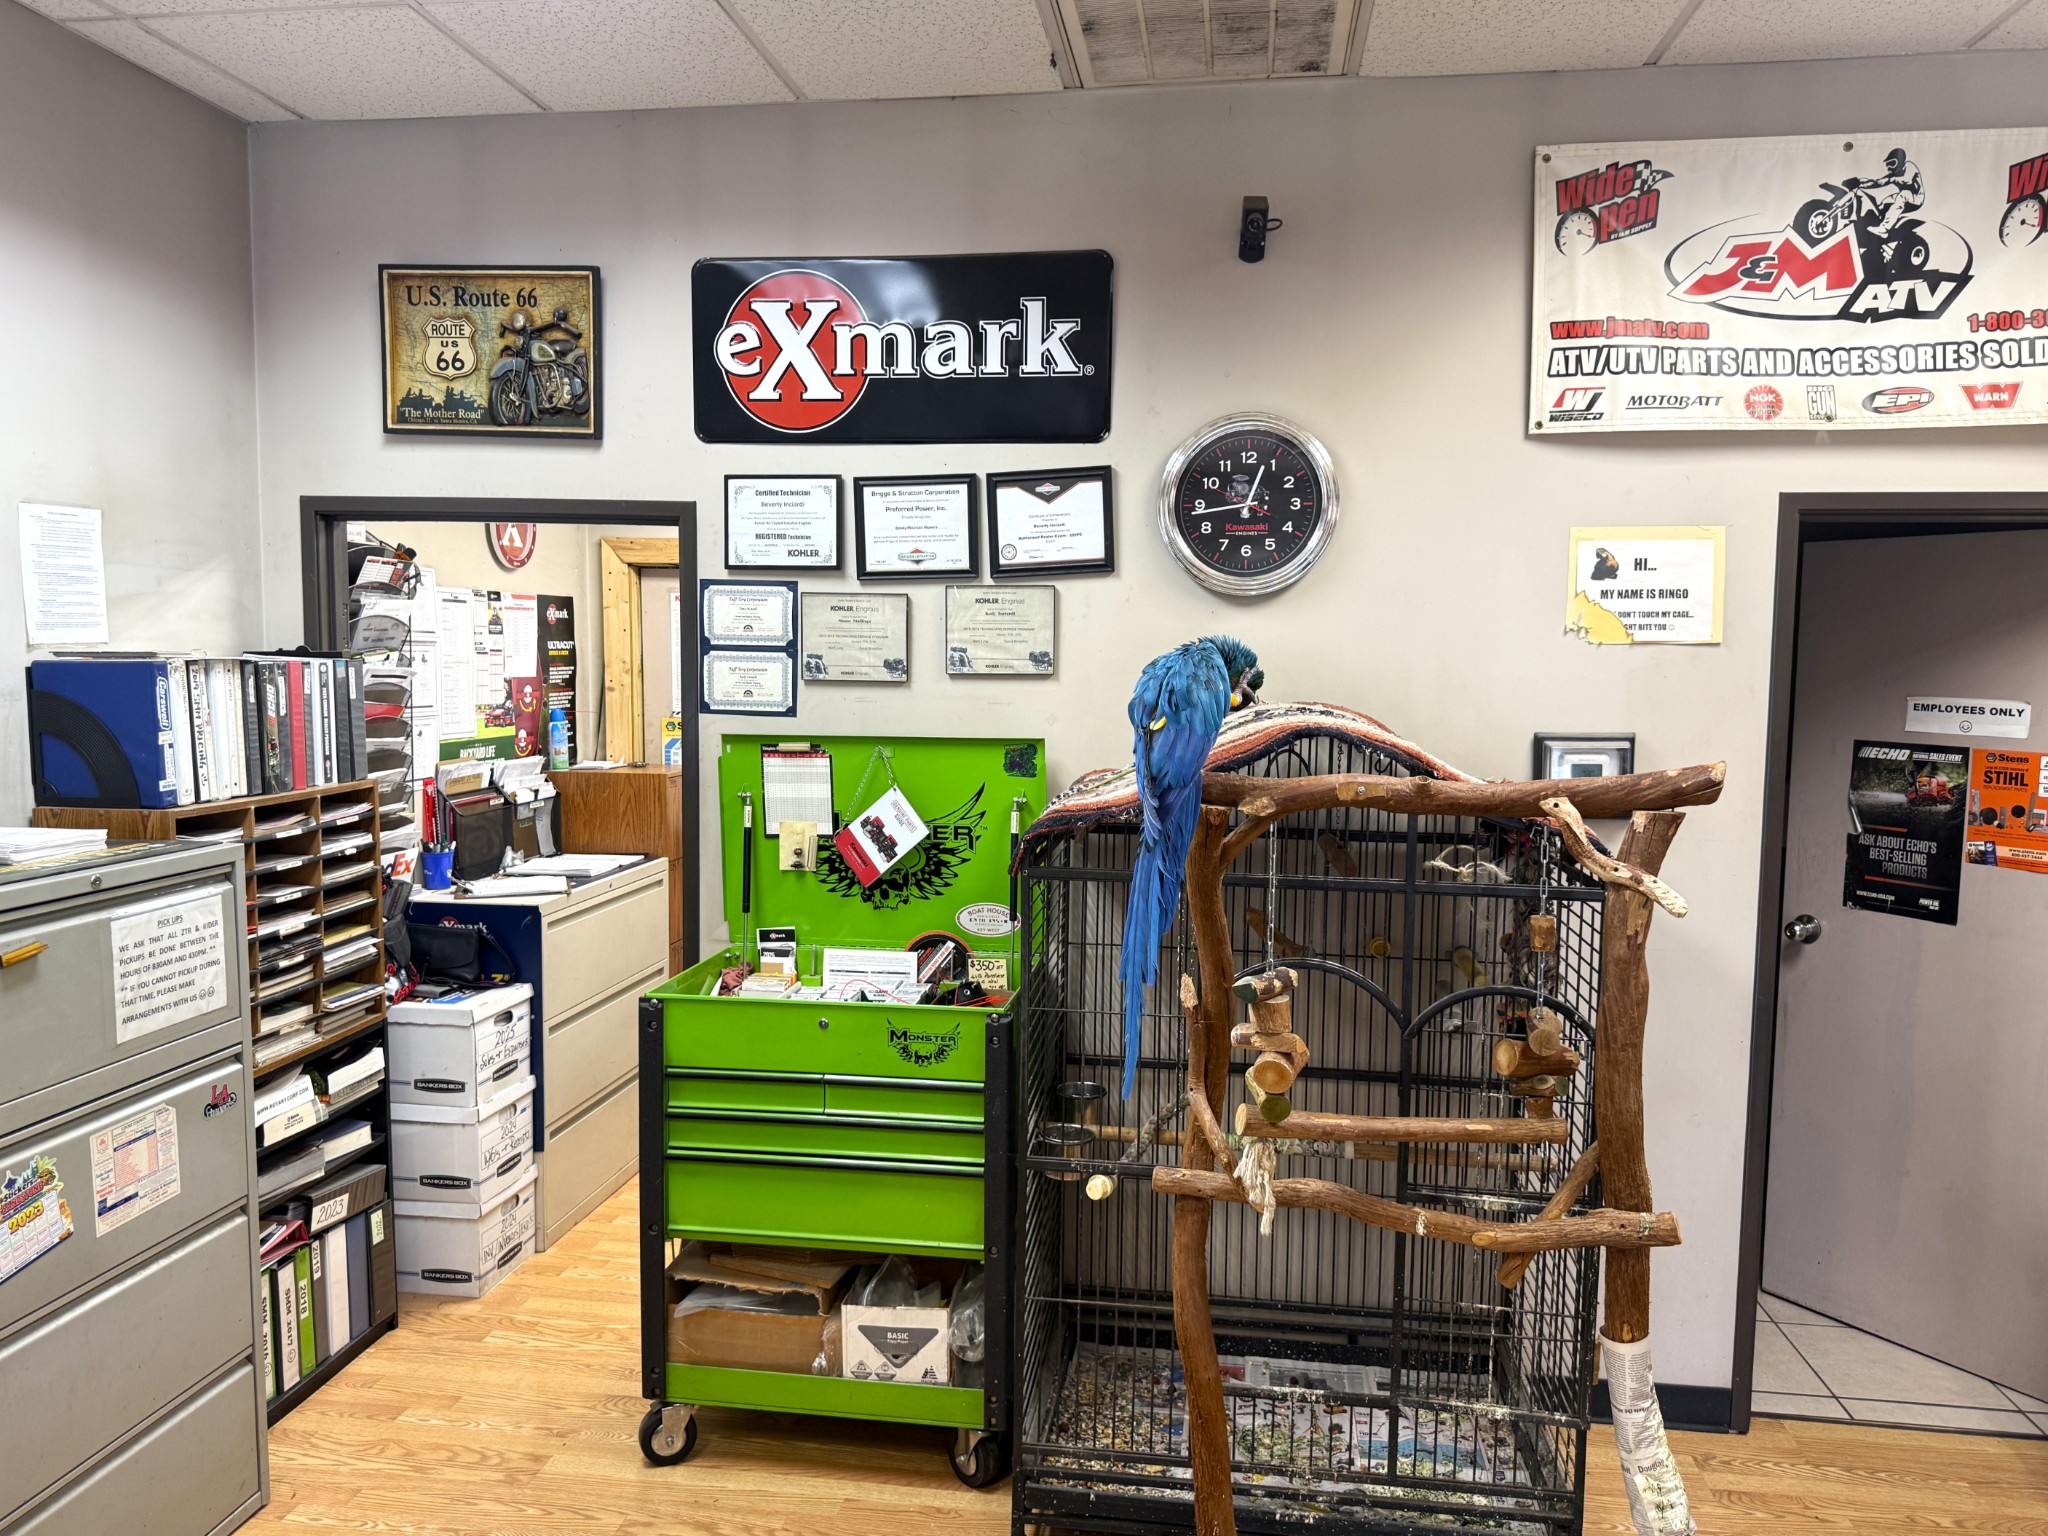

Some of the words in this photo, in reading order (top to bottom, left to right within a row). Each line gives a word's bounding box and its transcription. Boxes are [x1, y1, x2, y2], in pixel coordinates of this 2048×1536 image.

[1556, 163, 1635, 213] Wide
[1630, 222, 1653, 233] SUPPLY
[1683, 234, 1857, 296] J&M
[405, 285, 447, 307] U.S.
[453, 286, 510, 307] Route
[517, 287, 538, 308] 66
[1848, 280, 1957, 314] ATV
[431, 323, 465, 336] ROUTE
[1550, 317, 1710, 340] www.jmatv.com
[440, 340, 459, 348] US
[714, 296, 1084, 403] eXmark
[436, 351, 465, 372] 66
[1548, 344, 1659, 377] ATV/UTV
[1662, 346, 1740, 376] PARTS
[1741, 346, 1795, 377] AND
[1797, 340, 1979, 377] ACCESSORIES
[1980, 336, 2048, 369] SOLD
[1626, 395, 1724, 410] MOTOBATT
[1749, 393, 1776, 402] NGK
[1807, 391, 1836, 415] GUN
[1871, 393, 1930, 409] EPI
[1973, 392, 2009, 401] WARN
[400, 407, 422, 417] "The
[423, 408, 456, 418] Mother
[458, 408, 485, 419] Road"
[1549, 412, 1605, 423] WISECO
[1240, 452, 1258, 464] 12
[1270, 459, 1276, 471] 1
[1218, 460, 1231, 472] 11
[1202, 477, 1219, 490] 10
[1283, 476, 1295, 488] 2
[755, 489, 779, 497] Certified
[871, 490, 890, 498] Briggs
[924, 489, 960, 497] Corporation
[1194, 499, 1206, 511] 9
[1290, 498, 1301, 510] 3
[1201, 522, 1212, 534] 8
[1225, 522, 1269, 531] Kawasaki
[1282, 521, 1293, 533] 4
[1219, 539, 1230, 551] 7
[1240, 545, 1252, 557] 6
[1265, 538, 1276, 550] 5
[787, 549, 819, 557] KOHLER
[1633, 557, 1657, 571] HI...
[1600, 589, 1615, 600] MY
[1617, 588, 1644, 599] NAME
[1646, 588, 1656, 599] IS
[1658, 588, 1689, 599] RINGO
[855, 605, 879, 613] Engines
[1001, 598, 1025, 606] Engines
[1617, 611, 1637, 619] DON'T
[1661, 610, 1672, 618] MY
[1638, 623, 1653, 631] BITE
[1653, 623, 1667, 631] YOU
[159, 680, 169, 729] Carswell
[266, 684, 276, 718] ECHO
[192, 694, 202, 723] SMM
[1913, 702, 1986, 716] EMPLOYEES
[1989, 707, 2025, 718] ONLY
[195, 723, 206, 769] PRICING
[485, 745, 496, 757] LIFE
[1869, 748, 1911, 761] ECHO
[1929, 752, 1945, 761] SALES
[1945, 753, 1963, 762] EVENT
[1998, 753, 2030, 763] Stens
[1983, 770, 2029, 787] STIHL
[1858, 833, 1876, 845] ASK
[1876, 835, 1905, 849] ABOUT
[1906, 838, 1937, 854] ECHO'S
[849, 842, 869, 867] Kawasaki
[1869, 847, 1927, 866] BEST-SELLING
[1882, 861, 1928, 879] PRODUCTS
[967, 907, 985, 917] BOAT
[986, 907, 1009, 919] HOUSE
[157, 916, 171, 927] PICK
[171, 914, 183, 924] UPS
[118, 943, 129, 953] WE
[133, 940, 145, 949] ASK
[149, 934, 164, 945] THAT
[167, 931, 178, 940] ALL
[181, 927, 192, 936] ZTR
[202, 920, 219, 930] RIDER
[119, 953, 145, 967] PICKUPS
[148, 950, 156, 959] BE
[159, 944, 176, 955] DONE
[179, 936, 206, 949] BETWEEN
[209, 932, 219, 941] THE
[120, 967, 142, 980] HOURS
[142, 964, 151, 973] OF
[152, 958, 173, 971] 830AM
[174, 954, 187, 964] AND
[188, 948, 208, 959] 430PM.
[970, 960, 995, 971] $350
[130, 983, 136, 992] IF
[137, 979, 150, 990] YOU
[151, 971, 177, 986] CANNOT
[178, 965, 198, 978] PICKUP
[199, 958, 221, 970] DURING
[120, 997, 138, 1008] THAT
[138, 991, 156, 1002] TIME,
[156, 985, 177, 998] PLEASE
[178, 979, 195, 990] MAKE
[121, 1002, 172, 1025] ARRANGEMENTS
[173, 995, 189, 1007] WITH
[189, 993, 198, 1002] US
[494, 1023, 517, 1049] 2025
[888, 1028, 959, 1046] MONSTER
[416, 1081, 448, 1089] BANKERS
[256, 1086, 309, 1116] WWW.ROTARYCORP.COM
[501, 1121, 517, 1140] 2024
[422, 1177, 454, 1185] BANKERS
[8, 1200, 45, 1234] 2023
[316, 1199, 344, 1224] 2023
[500, 1212, 517, 1234] 2024
[311, 1244, 320, 1275] 2019
[284, 1287, 292, 1316] SMM
[887, 1332, 909, 1340] BASIC
